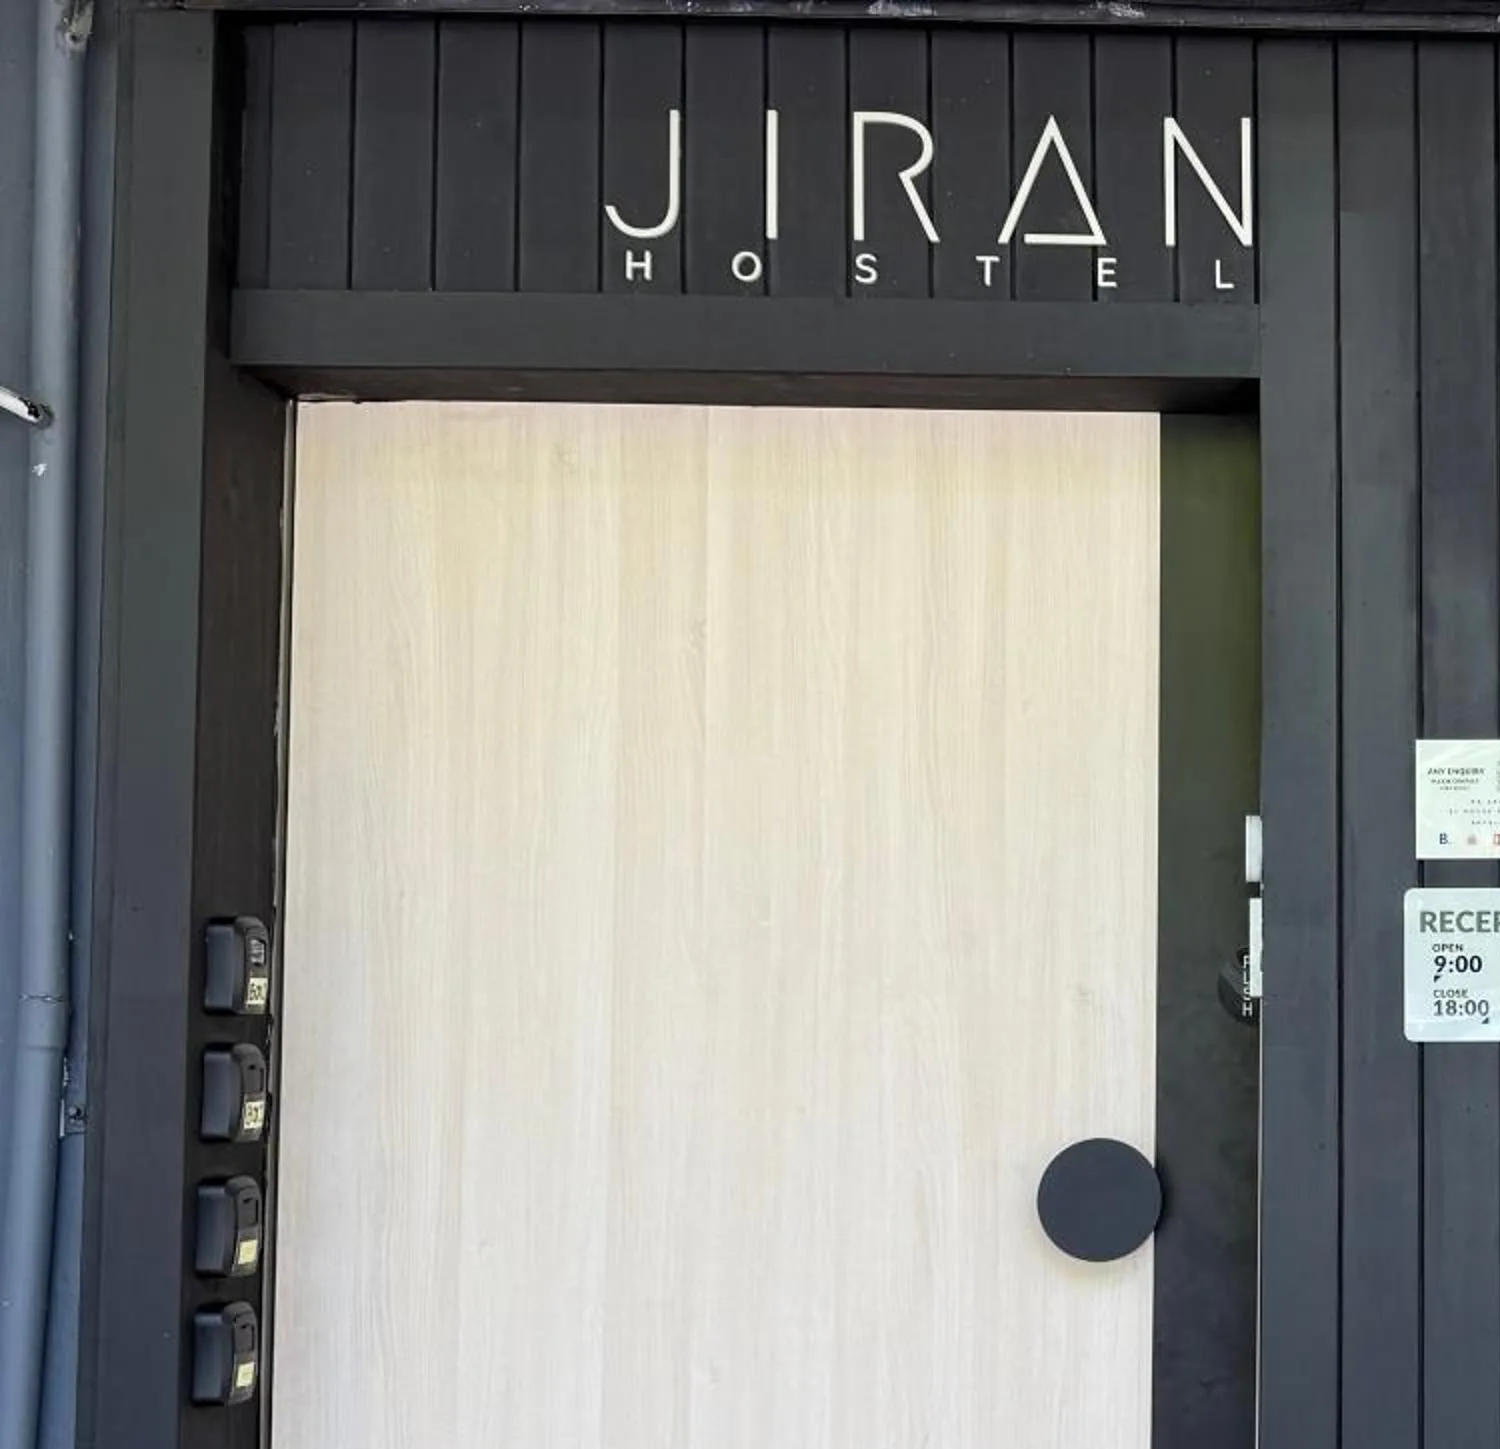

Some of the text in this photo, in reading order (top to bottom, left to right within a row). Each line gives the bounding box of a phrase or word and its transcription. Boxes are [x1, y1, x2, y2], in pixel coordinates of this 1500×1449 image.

[604, 108, 1252, 247] JIRAN
[625, 250, 1234, 290] HOSTEL
[1431, 943, 1464, 953] OPEN
[1433, 955, 1483, 973] 9:00
[1433, 989, 1468, 999] CLOSE
[1433, 999, 1490, 1017] 18:00
